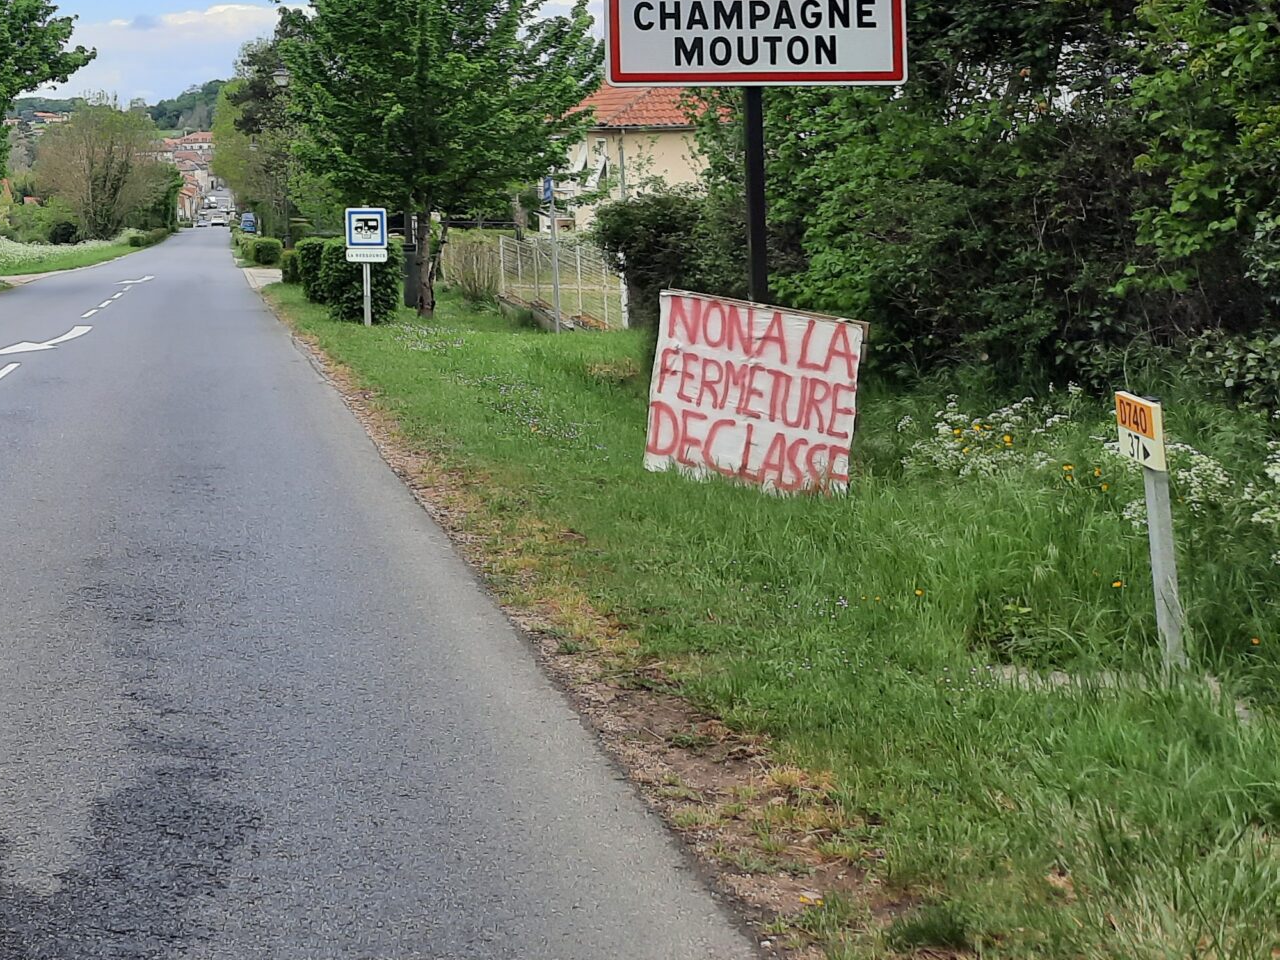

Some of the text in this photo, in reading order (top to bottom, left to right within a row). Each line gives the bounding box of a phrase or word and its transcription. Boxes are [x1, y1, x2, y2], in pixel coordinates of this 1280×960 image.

[674, 35, 837, 66] MOUTON
[668, 296, 858, 379] NON A LA
[657, 348, 857, 439] FERMETURE
[1119, 399, 1147, 434] D740
[1128, 432, 1140, 460] 37
